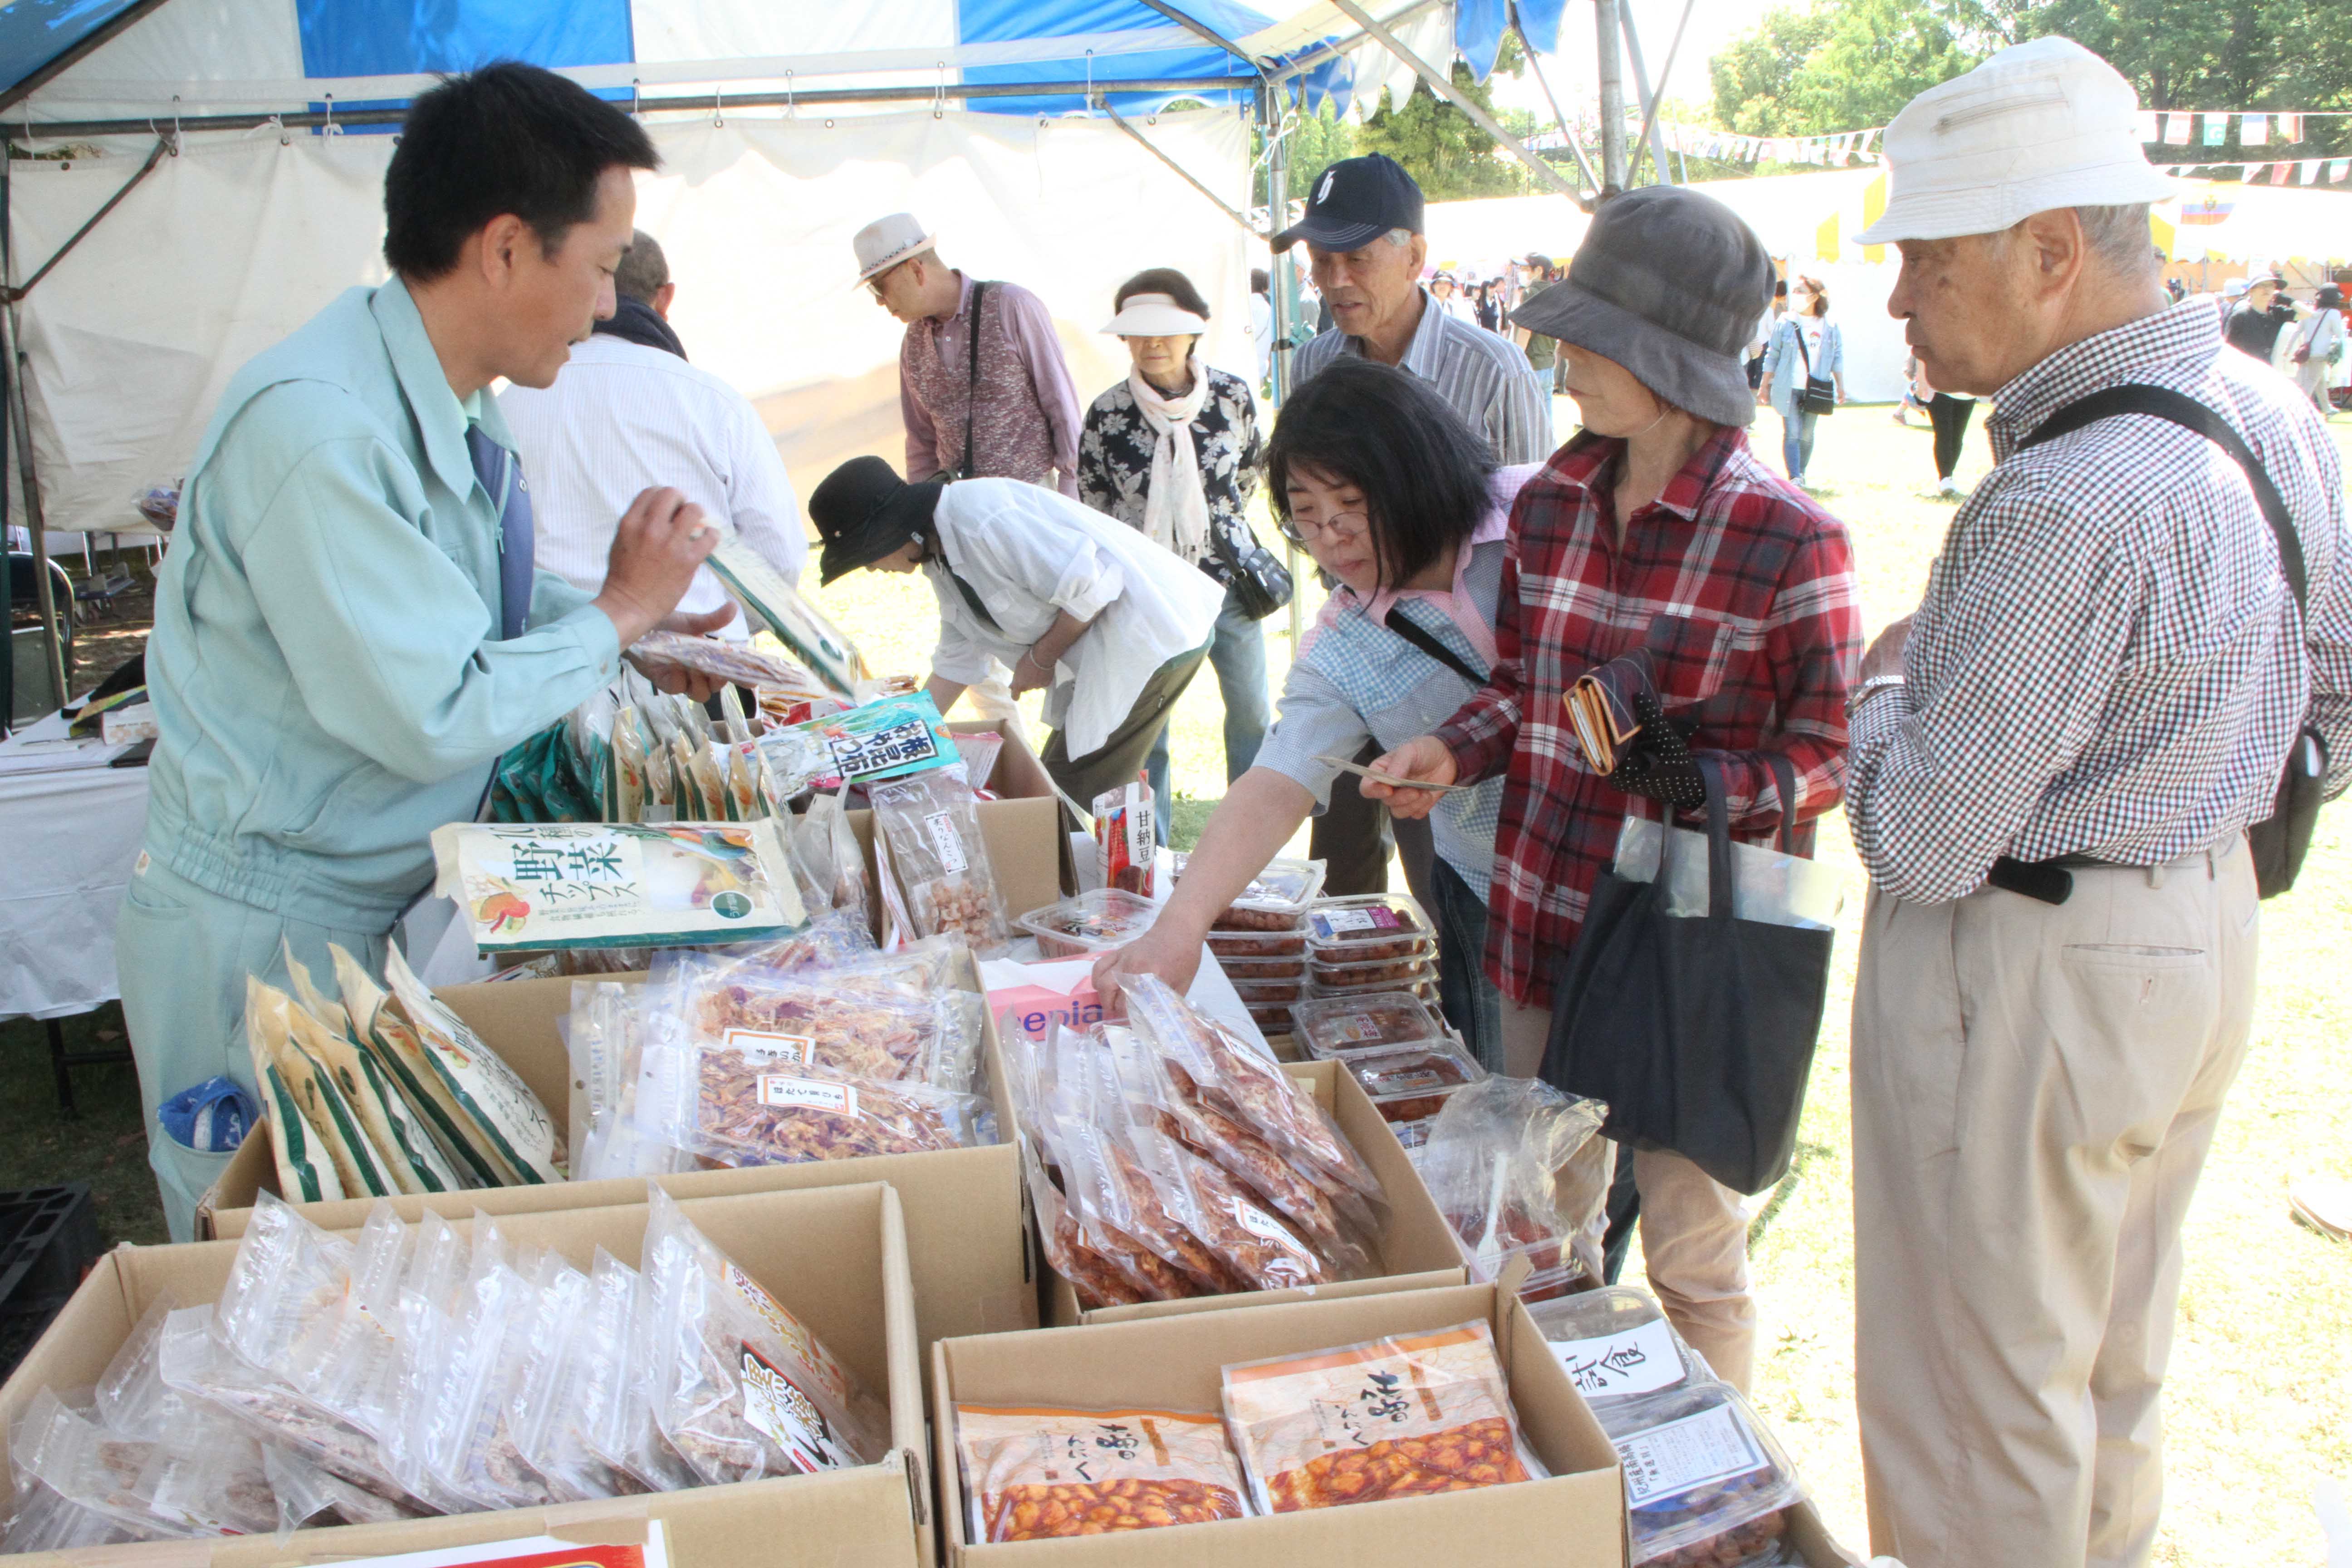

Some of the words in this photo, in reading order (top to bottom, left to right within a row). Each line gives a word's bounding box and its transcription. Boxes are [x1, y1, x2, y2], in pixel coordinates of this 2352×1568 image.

[836, 723, 921, 754] おやつ
[839, 735, 933, 772] 根昆布
[489, 826, 594, 840] 10種の
[1136, 810, 1151, 863] 甘納豆
[511, 841, 622, 881] 野菜
[539, 881, 640, 904] チップス
[1016, 1000, 1103, 1032] epia
[1565, 1341, 1646, 1392] 試食
